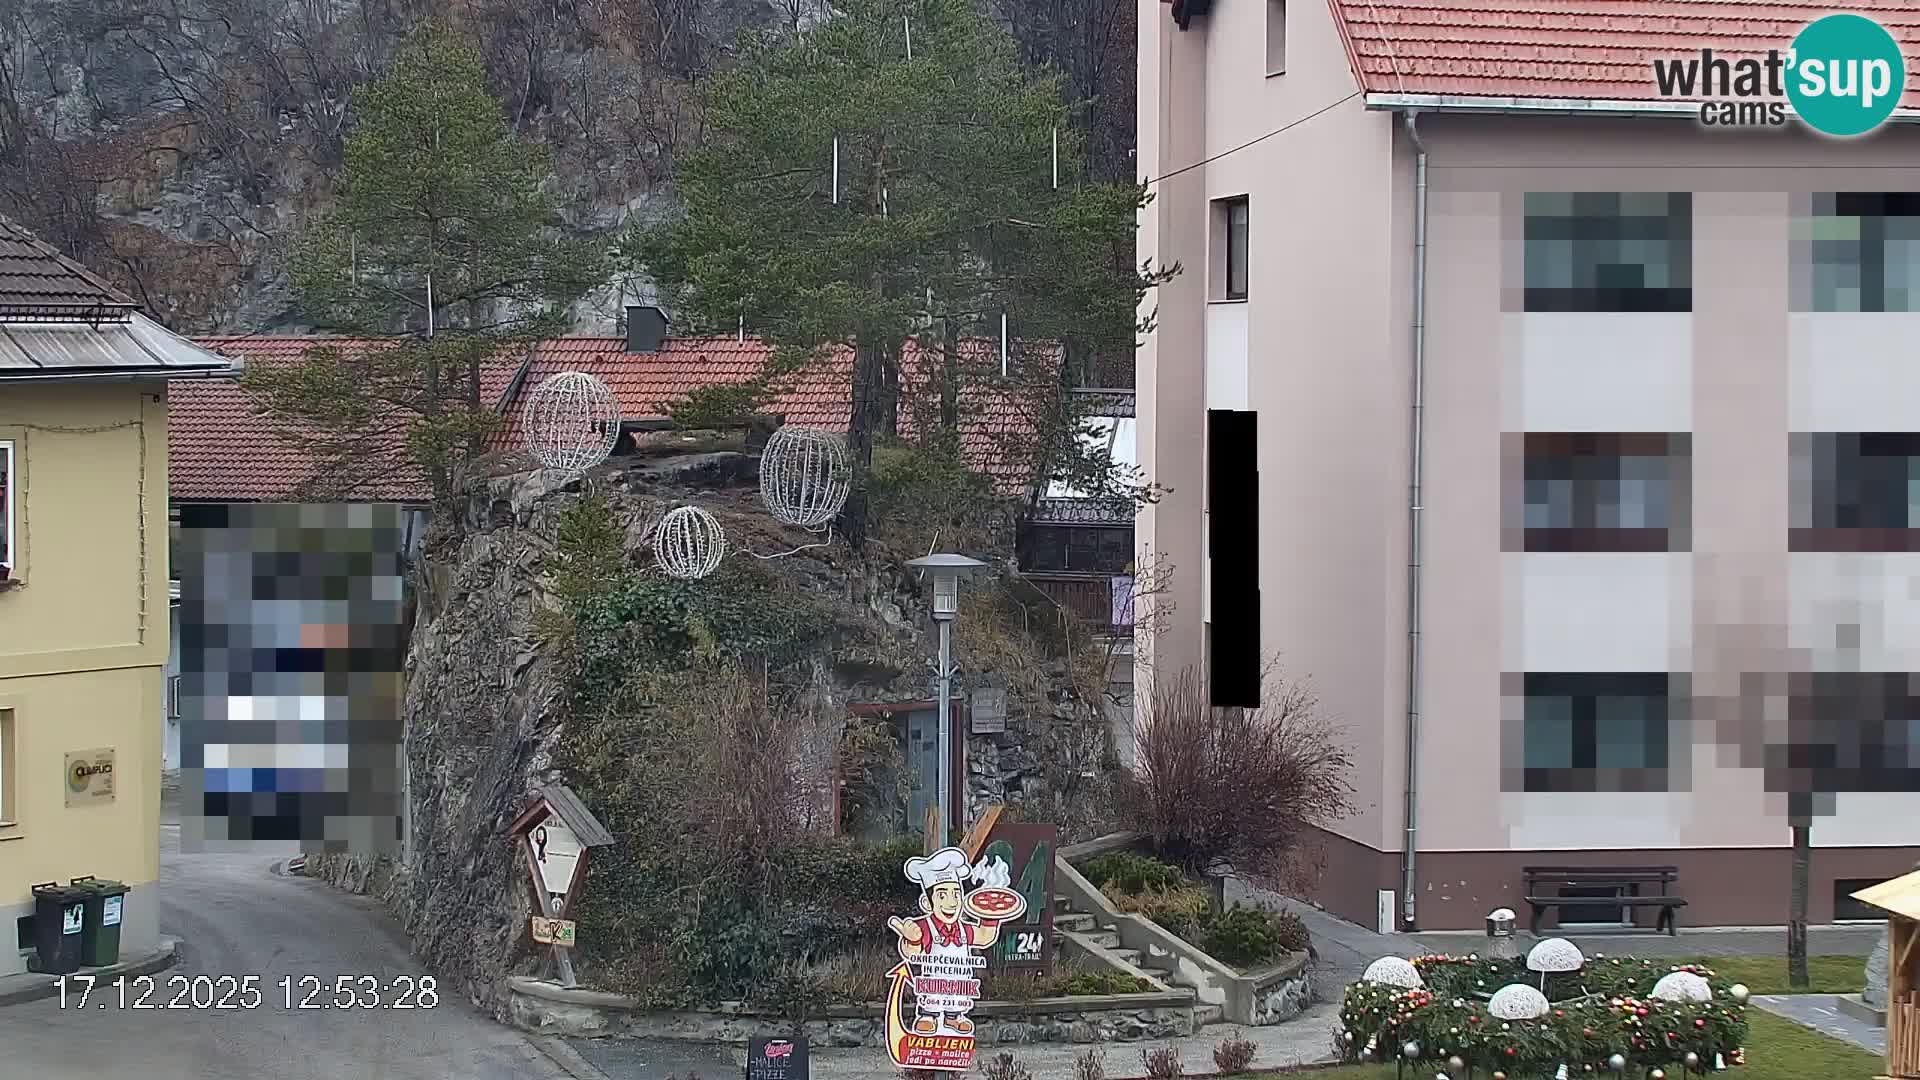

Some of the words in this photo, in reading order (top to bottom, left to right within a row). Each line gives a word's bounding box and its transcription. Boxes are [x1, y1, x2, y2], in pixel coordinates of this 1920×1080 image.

[910, 954, 986, 967] OKREPČEVALNICA
[923, 965, 933, 974] IN
[934, 966, 972, 976] PICERIJA
[915, 978, 979, 997] KURNIK
[907, 1036, 975, 1050] VABLJENI
[910, 1049, 932, 1057] pizza
[942, 1050, 970, 1058] malice
[906, 1056, 922, 1065] jedi
